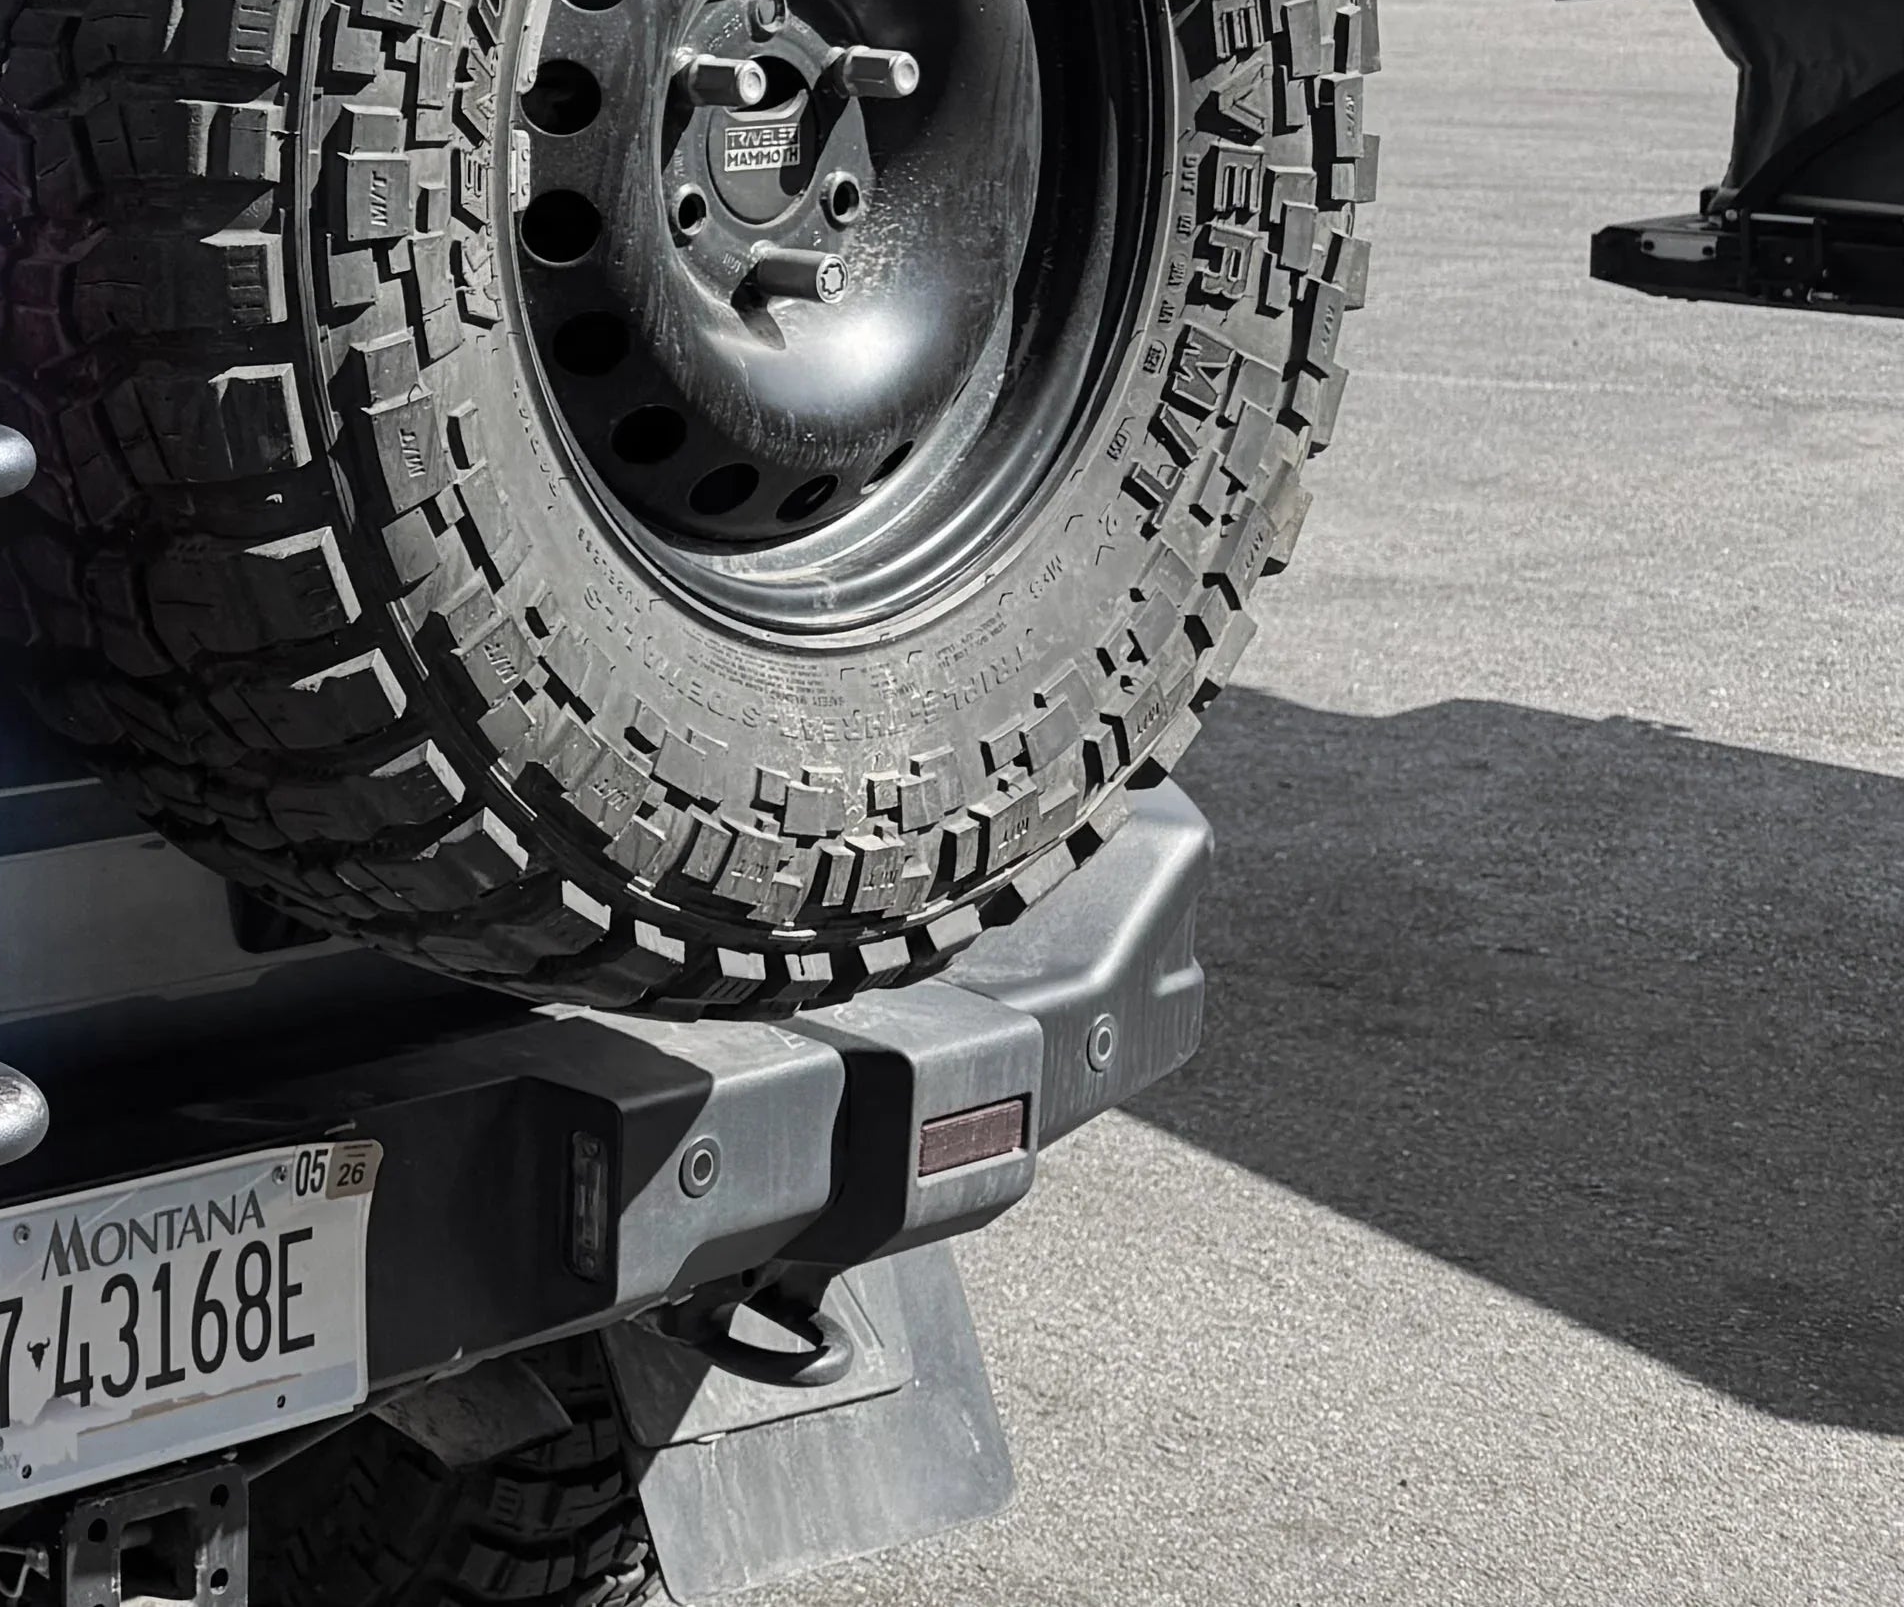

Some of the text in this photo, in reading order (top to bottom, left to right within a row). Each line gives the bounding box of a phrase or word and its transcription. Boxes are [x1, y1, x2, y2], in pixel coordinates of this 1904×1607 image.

[727, 146, 798, 169] MAMMOTH
[370, 170, 388, 227] M/T
[295, 1148, 329, 1197] 05
[336, 1161, 366, 1188] 26
[41, 1190, 266, 1281] MONTANA
